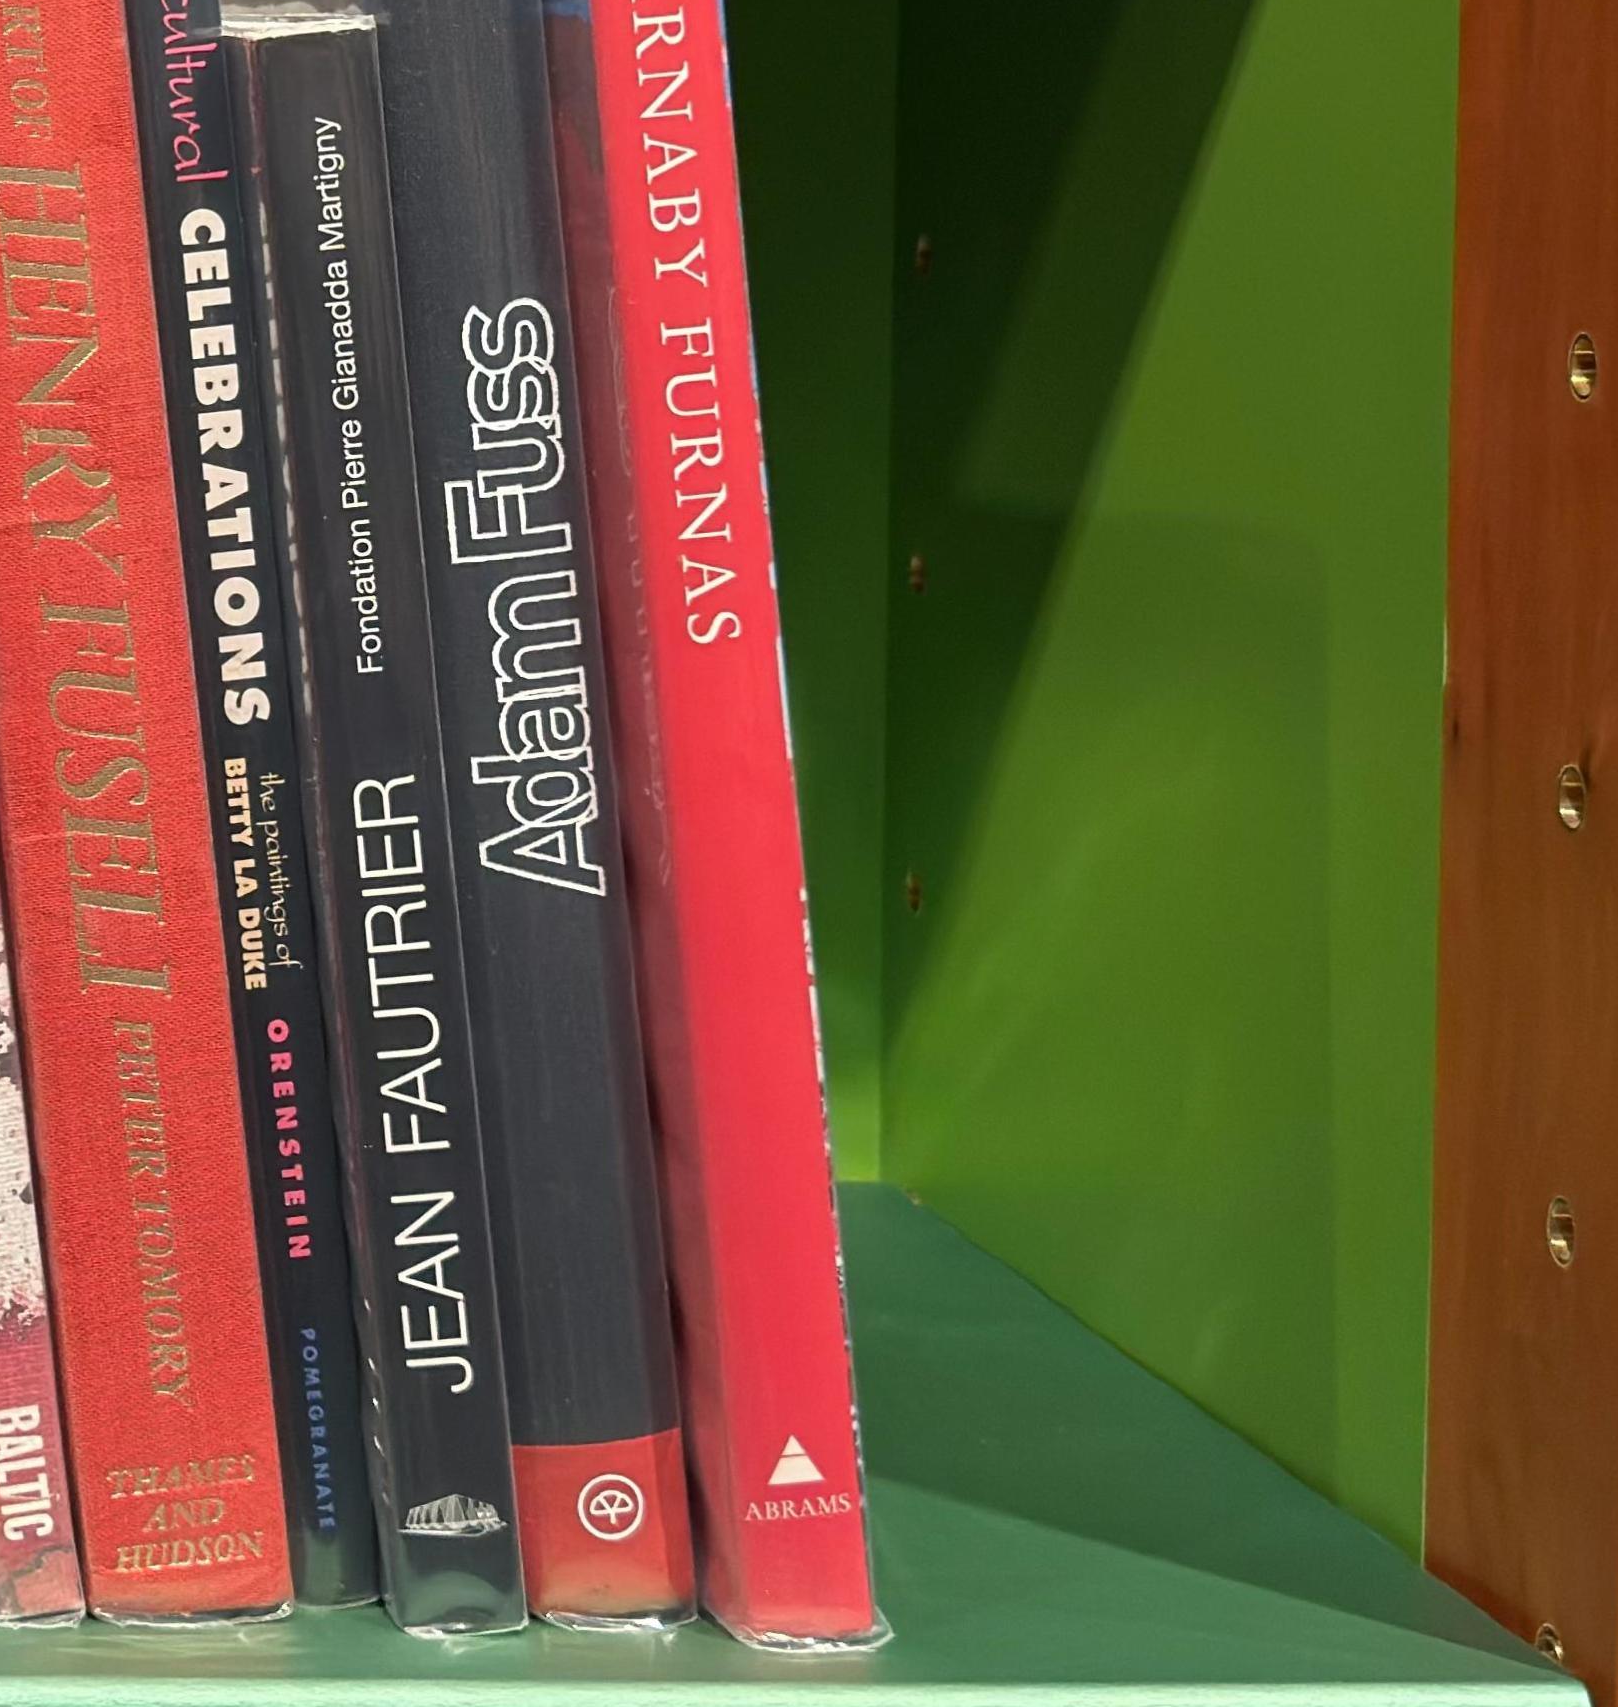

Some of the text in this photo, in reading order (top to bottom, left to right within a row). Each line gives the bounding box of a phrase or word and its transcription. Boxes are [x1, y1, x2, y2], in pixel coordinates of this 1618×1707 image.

[9, 80, 52, 141] OF
[179, 207, 271, 727] CELEBRATIONS
[312, 117, 384, 675] Fondation Pierre Gianadda Martigny
[661, 318, 743, 646] FURNAS
[445, 296, 605, 896] Adam Fuss
[41, 593, 175, 999] FUSELI
[223, 756, 268, 991] BETTY LA DUKE
[257, 771, 303, 969] the paintings of
[267, 1018, 314, 1260] ORENSTEIN
[353, 774, 476, 1393] JEAN FAUTRIER
[112, 1018, 196, 1413] PETER TOMORY
[107, 1454, 258, 1499] THAMES
[142, 1496, 226, 1532] AND
[300, 1328, 335, 1532] POMEGRANATE
[744, 1492, 853, 1521] ABRAMS
[115, 1529, 265, 1574] HUDSON
